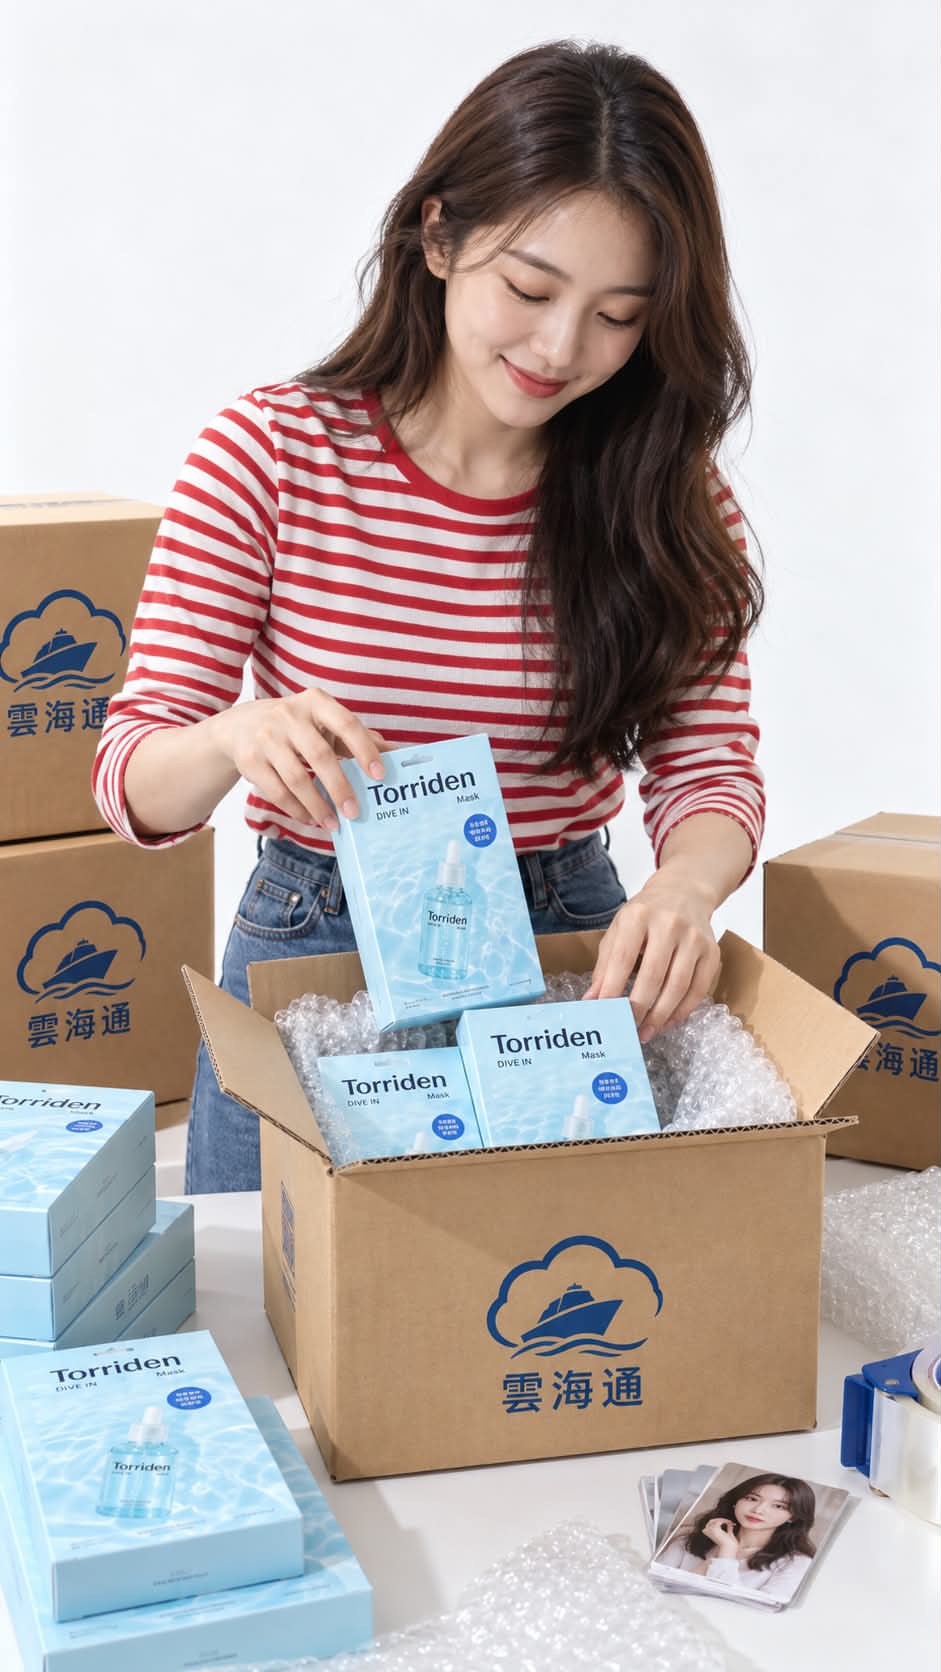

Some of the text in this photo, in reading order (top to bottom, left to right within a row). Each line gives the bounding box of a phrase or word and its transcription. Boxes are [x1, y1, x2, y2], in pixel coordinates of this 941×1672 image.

[8, 697, 110, 736] 雲海通
[368, 770, 476, 806] Torriden
[456, 792, 480, 804] Mask
[376, 807, 409, 821] DIVE IN
[428, 910, 467, 925] Torriden
[28, 1003, 132, 1048] 雲海通
[491, 1028, 602, 1054] Torriden
[497, 1058, 532, 1068] DIVE IN
[581, 1051, 606, 1060] Mask
[857, 1042, 939, 1082] 海通
[342, 1073, 447, 1095] Torriden
[427, 1092, 450, 1101] Mask
[50, 1355, 181, 1383] Torriden
[56, 1384, 81, 1392] DIVE
[502, 1366, 643, 1413] 雲海通
[113, 1461, 171, 1472] Torriden
